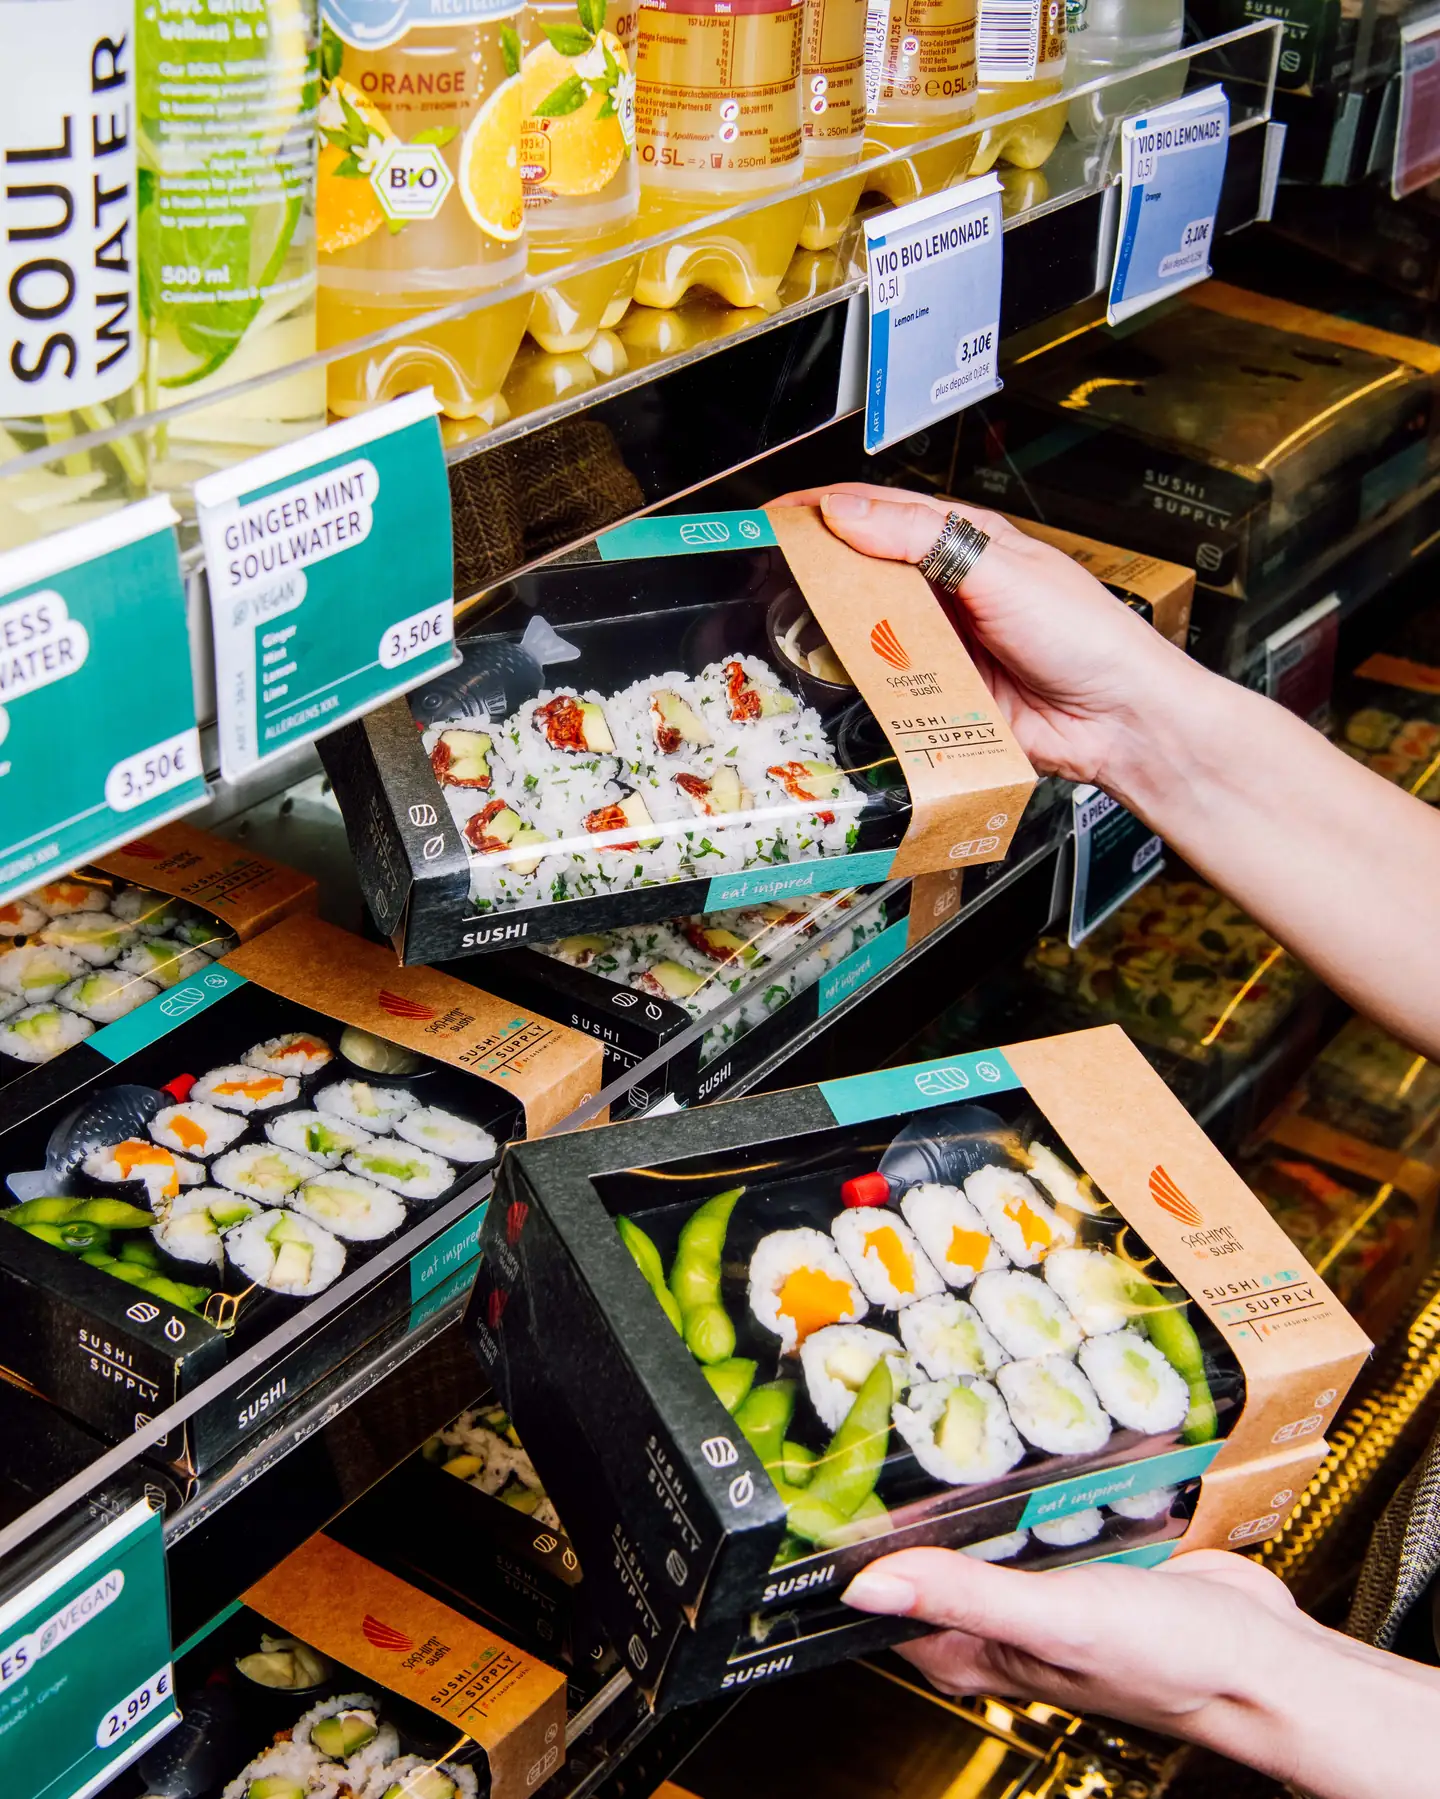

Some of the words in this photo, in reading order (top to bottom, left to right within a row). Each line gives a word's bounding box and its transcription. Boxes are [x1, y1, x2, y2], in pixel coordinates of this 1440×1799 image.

[1244, 1, 1290, 18] SUSHI
[360, 71, 466, 96] ORANGE
[943, 78, 968, 97] 0,5L
[1138, 133, 1155, 155] VIO
[1157, 129, 1173, 151] BIO
[1174, 120, 1221, 148] LEMONADE
[642, 145, 685, 167] 0,5L
[738, 156, 767, 168] 250ml
[92, 31, 130, 374] WATER
[6, 115, 76, 383] SOUL
[876, 250, 899, 277] VIO
[901, 241, 923, 268] BIO
[925, 216, 989, 259] LEMONADE
[1185, 223, 1210, 248] 3,10€
[161, 266, 201, 284] 500
[204, 264, 231, 284] ml
[878, 278, 899, 305] 0,5l
[894, 311, 915, 328] Lemon
[915, 305, 930, 320] Lime
[961, 331, 992, 363] 3,10€
[935, 379, 949, 400] plus
[949, 370, 974, 393] deposit
[1144, 469, 1205, 499] SUSHI
[225, 497, 308, 551] GINGER
[315, 472, 366, 514] MINT
[1153, 496, 1230, 531] SUPPLY
[230, 511, 362, 586] SOULWATER
[253, 579, 296, 616] VEGAN
[390, 614, 443, 659] 3,50€
[886, 672, 936, 688] SASHIMI
[910, 682, 942, 697] sushi
[891, 716, 947, 729] SUSHI
[928, 728, 996, 744] SUPPLY
[958, 750, 985, 759] SASHIMI
[121, 747, 186, 798] 3,50€
[181, 871, 223, 892] SUSHI
[721, 881, 748, 900] eat
[751, 871, 814, 896] inspired
[462, 921, 529, 949] SUSHI
[424, 1007, 466, 1034] SASHIMI
[450, 1014, 477, 1033] sushi
[571, 1014, 619, 1043] SUSHI
[459, 1035, 500, 1062] SUSHI
[496, 1025, 544, 1058] SUPPLY
[698, 1062, 731, 1100] SUSHI
[1181, 1226, 1235, 1249] SASHIMI
[1209, 1239, 1244, 1257] sushi
[421, 1255, 439, 1282] eat
[1202, 1278, 1260, 1299] SUSHI
[1245, 1288, 1315, 1313] SUPPLY
[1312, 1311, 1333, 1321] SUSHI
[79, 1329, 133, 1367] SUSHI
[90, 1358, 159, 1402] SUPPLY
[238, 1378, 287, 1430] SUSHI
[649, 1435, 688, 1504] SUSHI
[1038, 1492, 1065, 1515] eat
[1071, 1474, 1136, 1505] inspired
[648, 1467, 700, 1553] SUPPLY
[614, 1523, 650, 1592] SUSHI
[613, 1555, 659, 1639] SUPPLY
[762, 1564, 836, 1602] SUSHI
[57, 1575, 118, 1631] VEGAN
[402, 1636, 440, 1670] SASHIMI
[425, 1645, 452, 1666] sushi
[431, 1669, 472, 1703] SUSHI
[465, 1655, 514, 1698] SUPPLY
[497, 1679, 517, 1696] SASHIMI
[516, 1667, 531, 1680] SUSHI
[720, 1655, 794, 1689] SUSHI
[108, 1689, 151, 1737] 2,99
[156, 1674, 168, 1695] €
